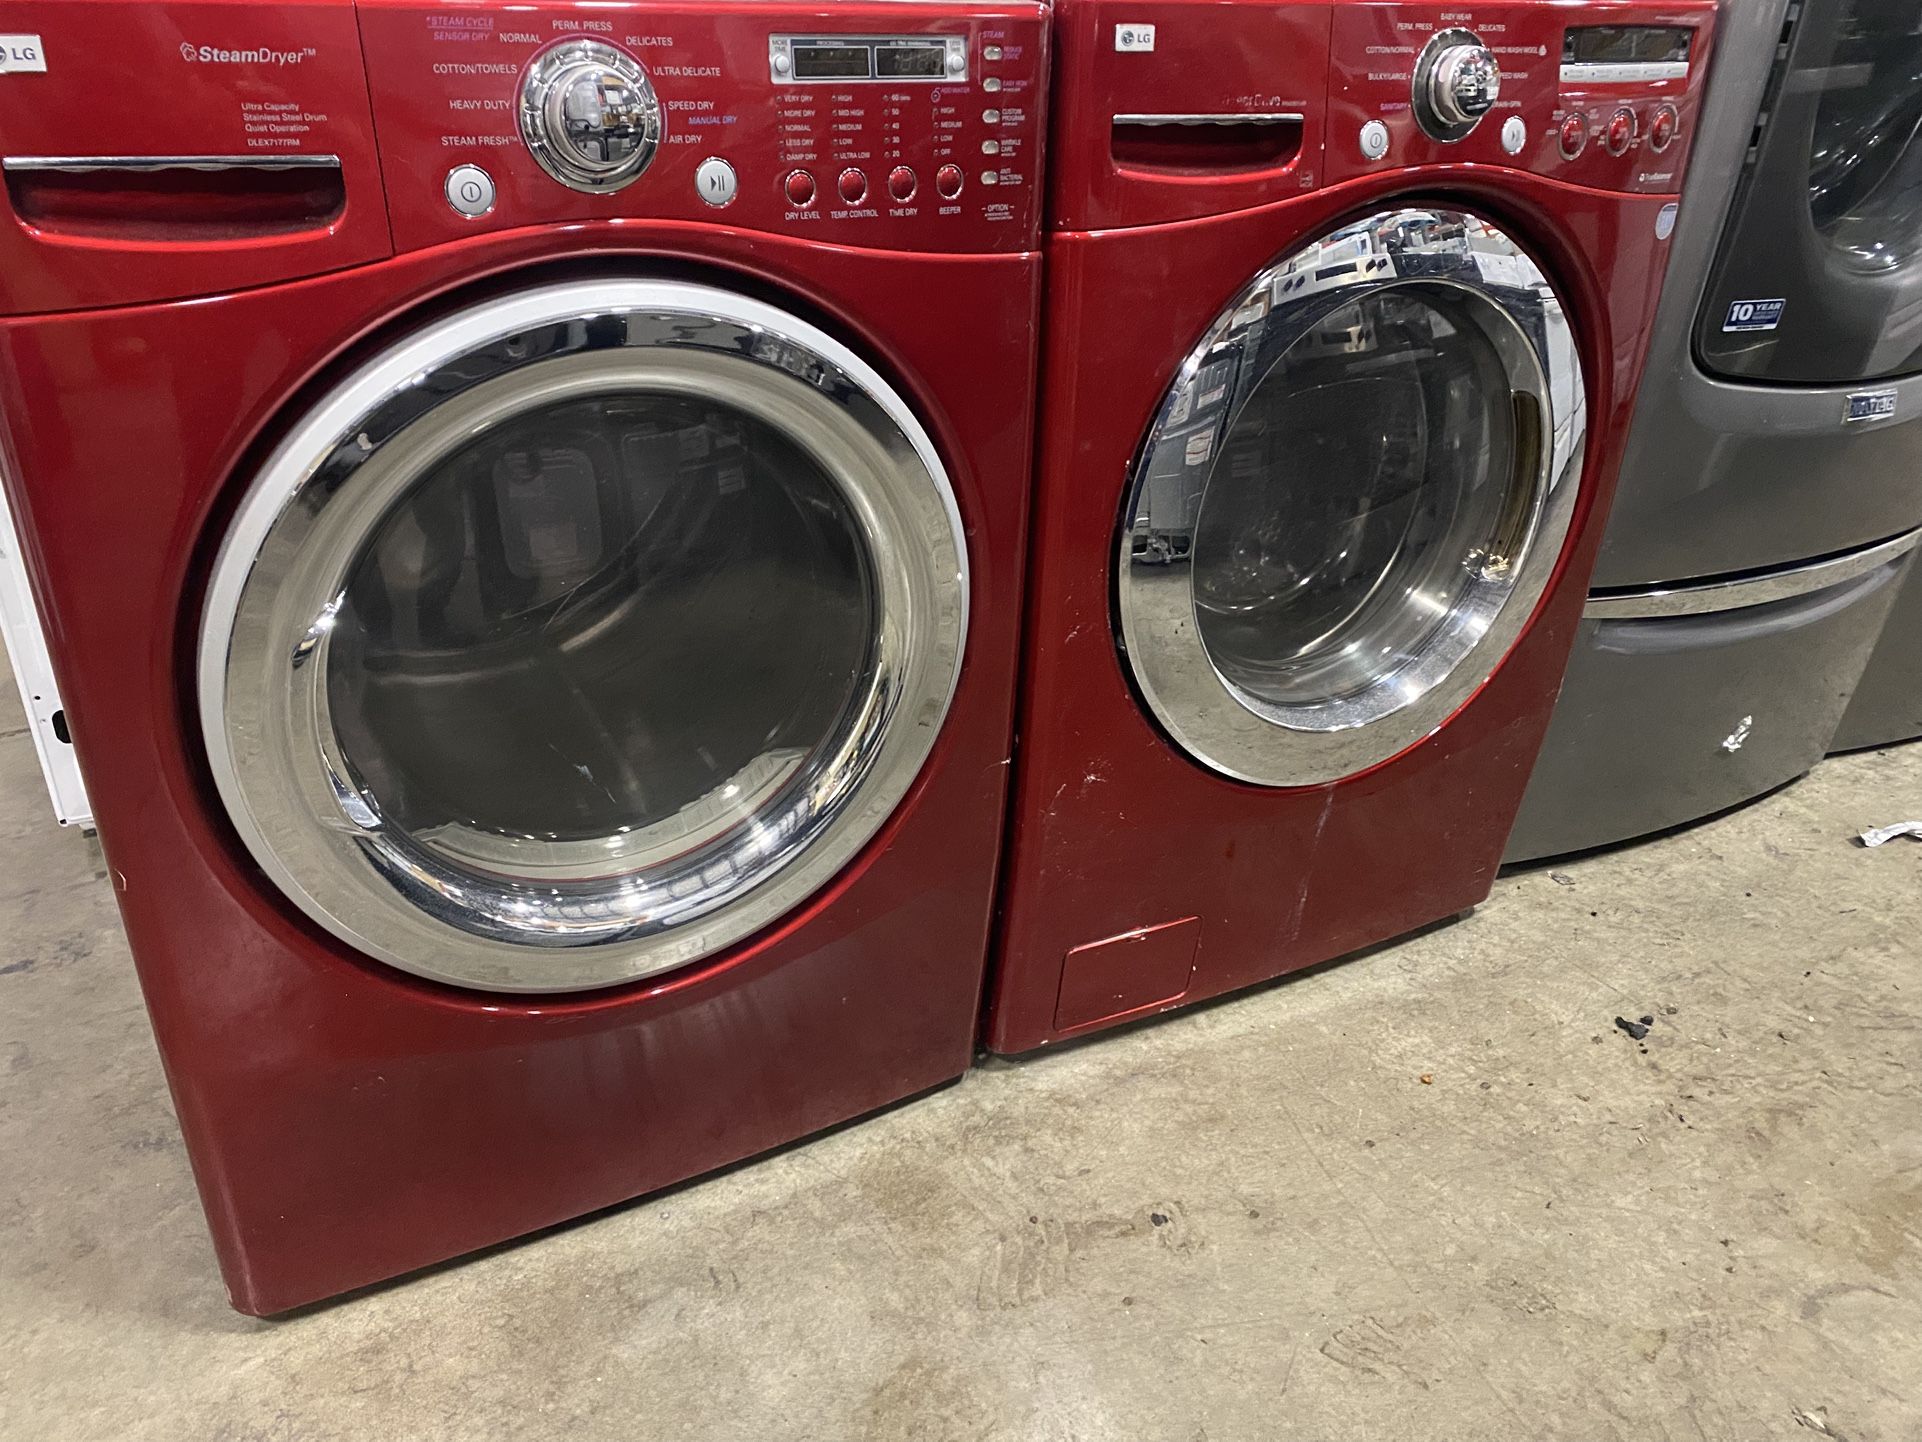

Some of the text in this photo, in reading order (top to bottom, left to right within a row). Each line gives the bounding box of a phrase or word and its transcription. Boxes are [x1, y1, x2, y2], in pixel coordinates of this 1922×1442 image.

[552, 20, 613, 31] PERM. PRESS
[471, 32, 490, 40] DRY
[499, 33, 542, 43] NORMAL
[626, 36, 673, 46] DELICATES
[1137, 33, 1150, 43] LG
[11, 47, 36, 60] LG
[433, 63, 517, 74] COTTON/TOWELS
[653, 66, 721, 77] ULTRA DELICATE
[241, 102, 299, 112] Ultra Capacity
[449, 100, 510, 110] HEAVY DUTY
[668, 101, 714, 110] SPEED DRY
[243, 112, 327, 121] Stainless Steel Drum
[688, 115, 737, 125] MANUAL DRY
[245, 123, 310, 133] Quiet Operation
[441, 136, 476, 146] STEAM
[669, 134, 702, 144] AIR DRY
[905, 207, 918, 216] DRY
[987, 203, 1009, 212] OPTION
[785, 211, 820, 220] DRY LEVEL
[849, 209, 879, 219] CONTROL
[1731, 304, 1754, 321] 10
